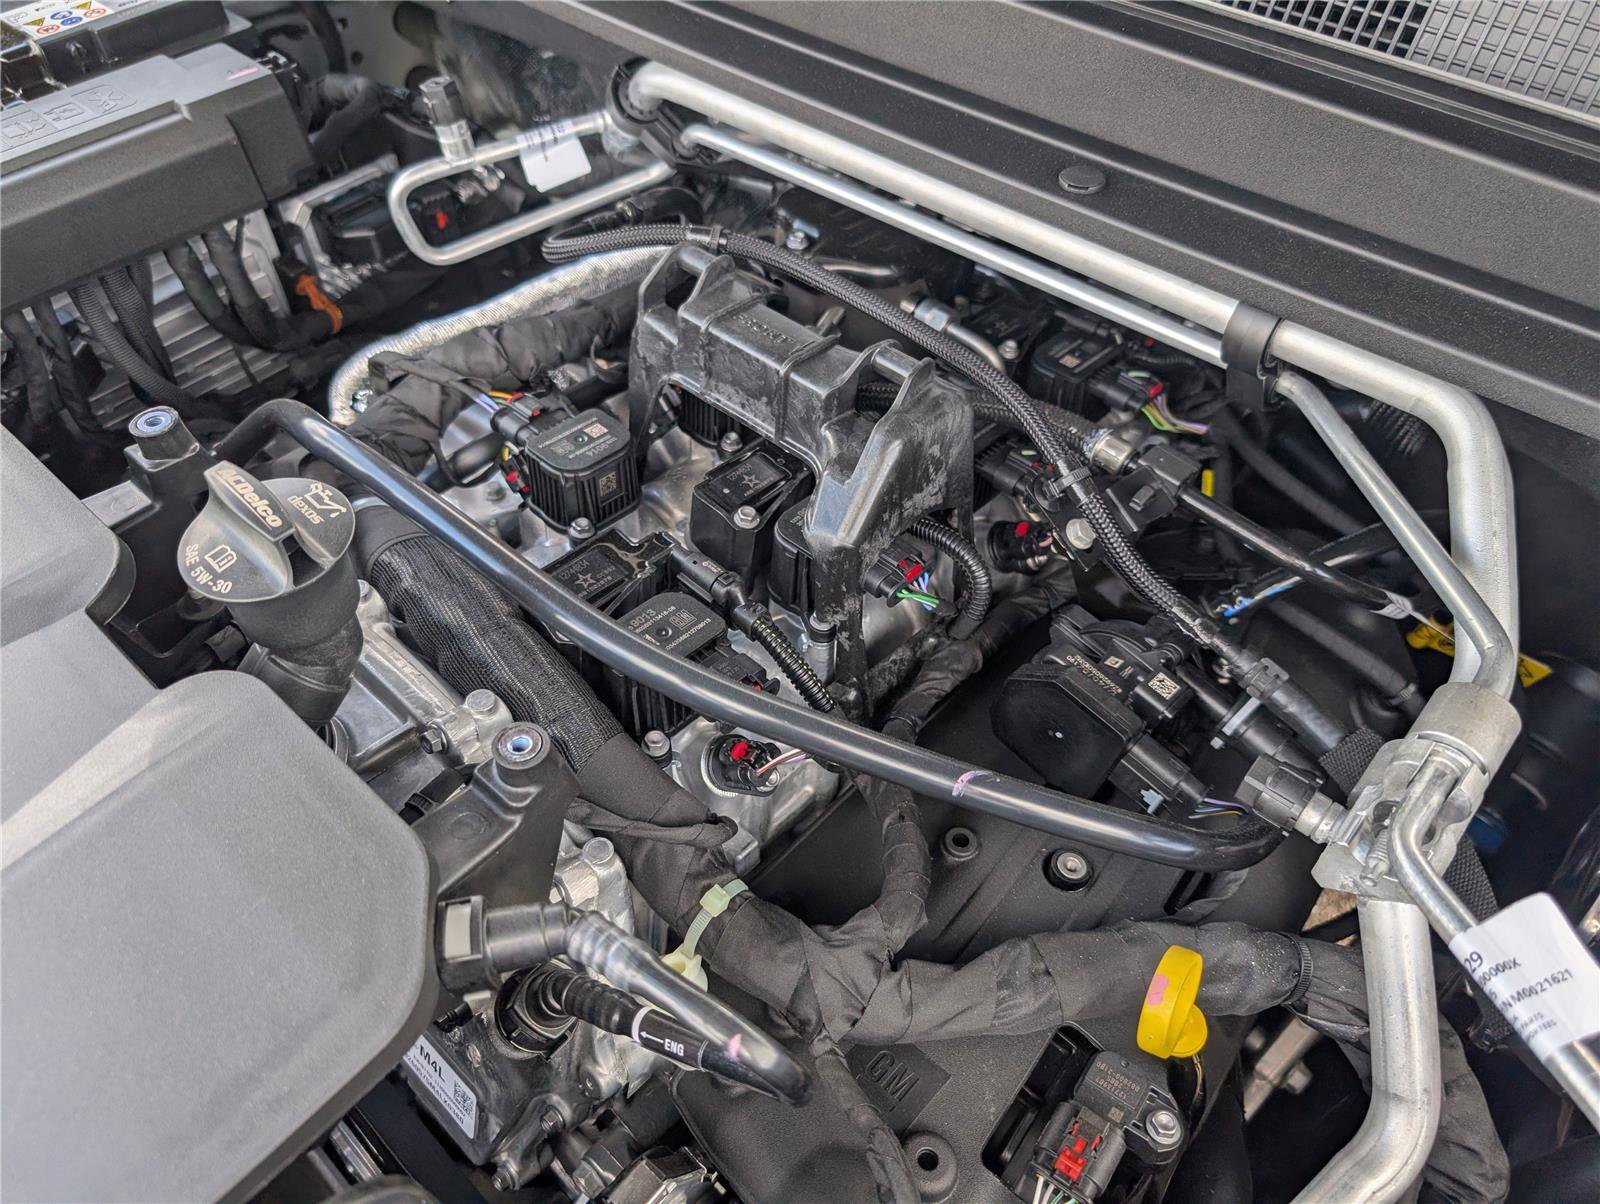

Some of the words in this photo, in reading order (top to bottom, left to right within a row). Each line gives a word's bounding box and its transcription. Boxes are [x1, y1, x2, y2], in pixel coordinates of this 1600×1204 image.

[216, 468, 283, 528] ACDelco
[185, 543, 200, 567] SAE
[191, 566, 233, 594] 5W-30
[419, 1044, 445, 1083] M4L
[664, 1038, 685, 1056] ENG
[865, 1050, 920, 1102] GM
